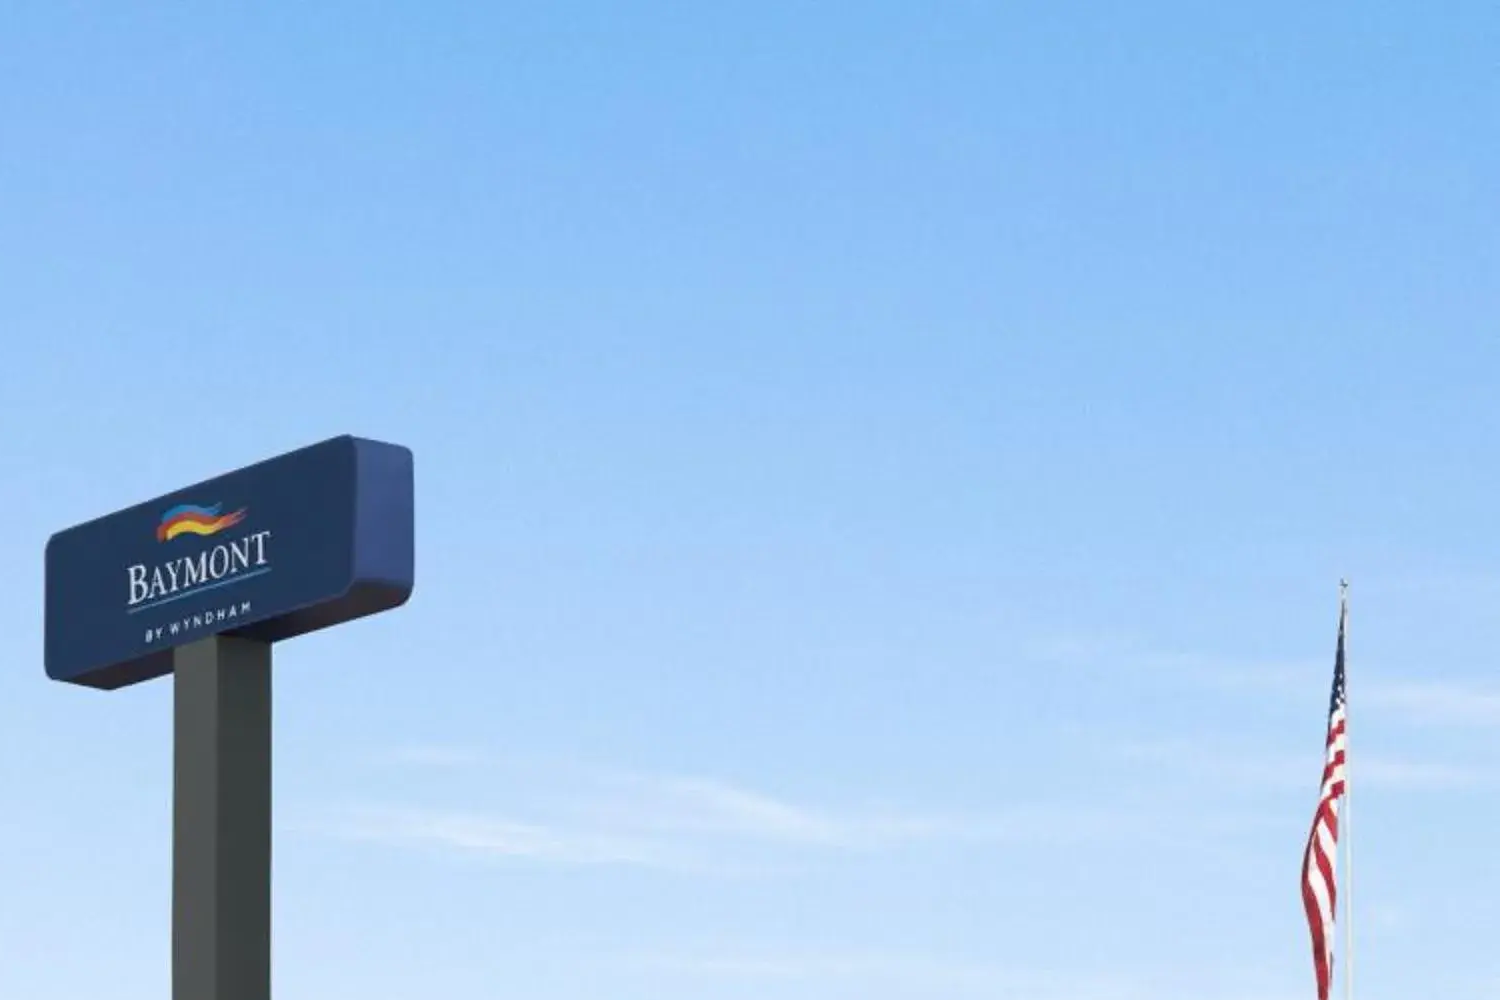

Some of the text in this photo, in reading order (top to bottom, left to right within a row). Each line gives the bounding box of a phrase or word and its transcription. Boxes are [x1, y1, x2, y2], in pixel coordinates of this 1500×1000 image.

[127, 531, 270, 605] BAYMONT
[145, 601, 252, 643] BY WYNDHAM
